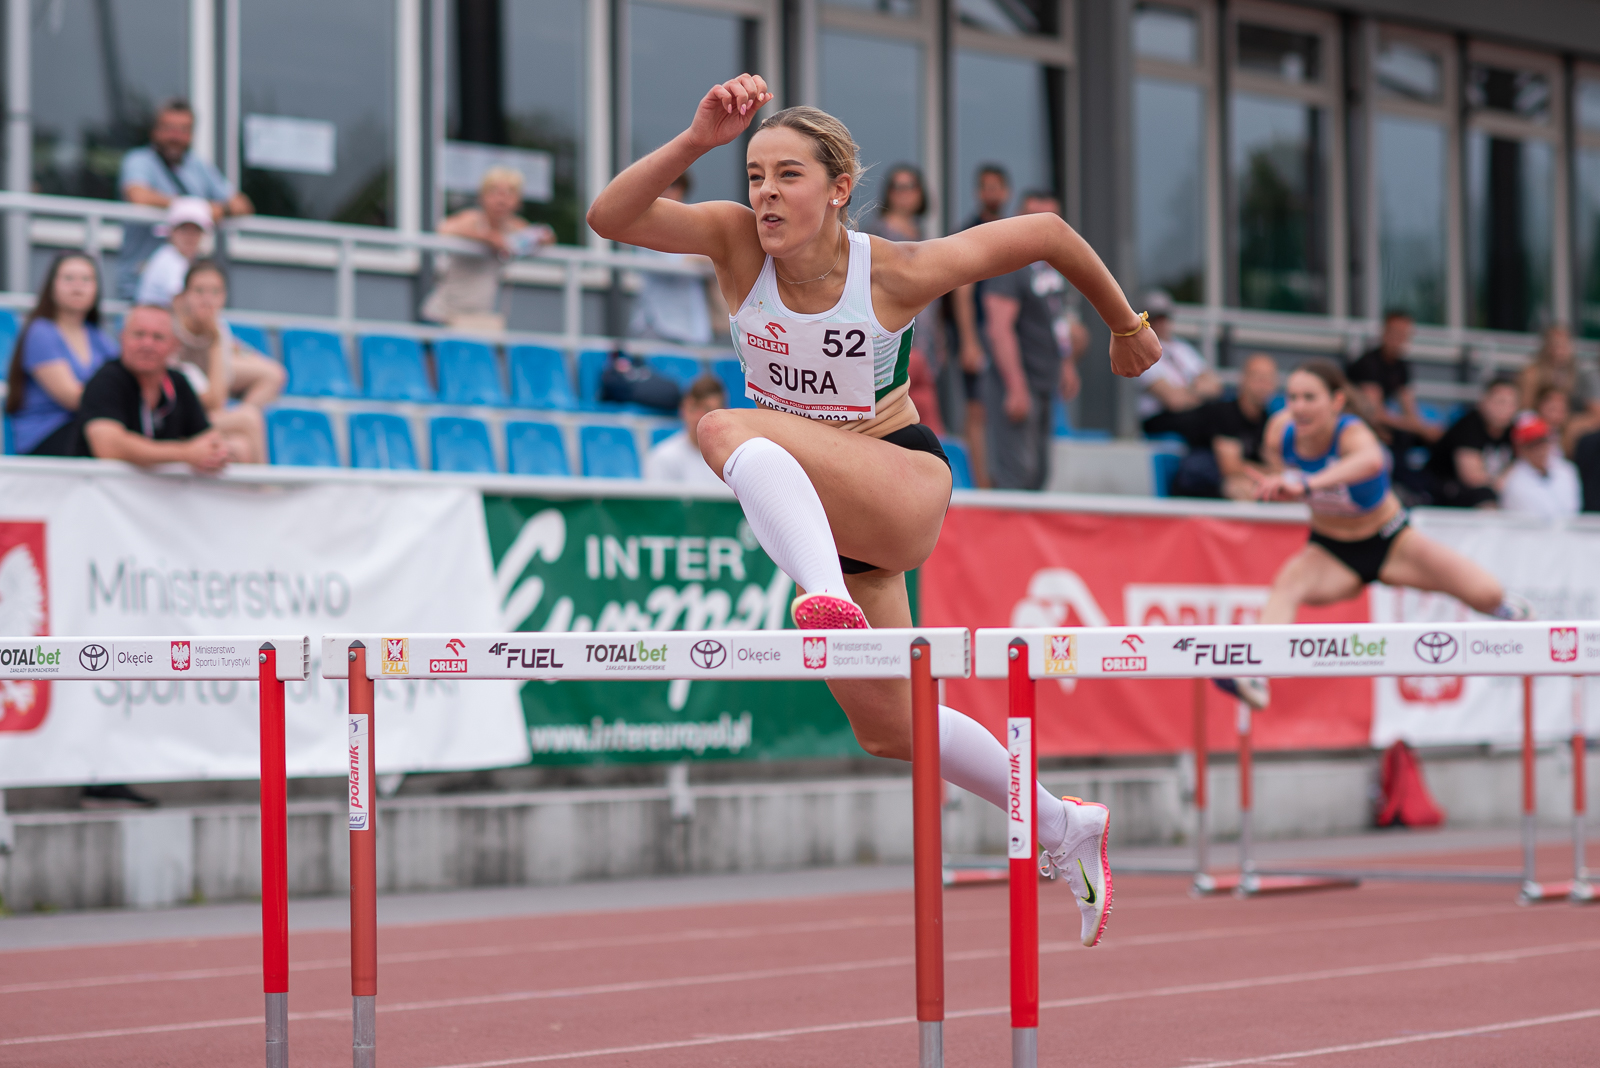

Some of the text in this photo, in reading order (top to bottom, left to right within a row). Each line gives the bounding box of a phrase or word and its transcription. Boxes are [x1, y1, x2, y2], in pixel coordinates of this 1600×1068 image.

[749, 336, 787, 354] ORLEN
[822, 329, 867, 358] 52
[768, 362, 839, 395] SURA
[585, 534, 746, 580] INTER
[88, 559, 352, 618] Ministerstwo
[195, 646, 236, 654] Ministerstwo
[585, 640, 668, 663] TOTALbet
[832, 642, 882, 652] Ministerstwo
[1172, 637, 1263, 665] 4F FUEL
[1289, 633, 1387, 658] TOTALbet
[1470, 639, 1524, 657] Okęcie
[0, 645, 61, 666] OTALbet
[117, 651, 153, 667] Okęcie
[195, 658, 217, 668] Sportu
[221, 657, 251, 668] Turystyki
[488, 642, 564, 669] 4F FUEL
[737, 648, 781, 665] Okęcie
[832, 655, 859, 667] Sportu
[864, 655, 901, 667] Turystyki
[1103, 658, 1145, 671] ORLEN
[383, 662, 408, 673] PZLA
[431, 660, 466, 672] ORLEN
[1046, 660, 1075, 673] PZLA
[349, 744, 363, 809] polanik
[1009, 752, 1025, 823] polanik
